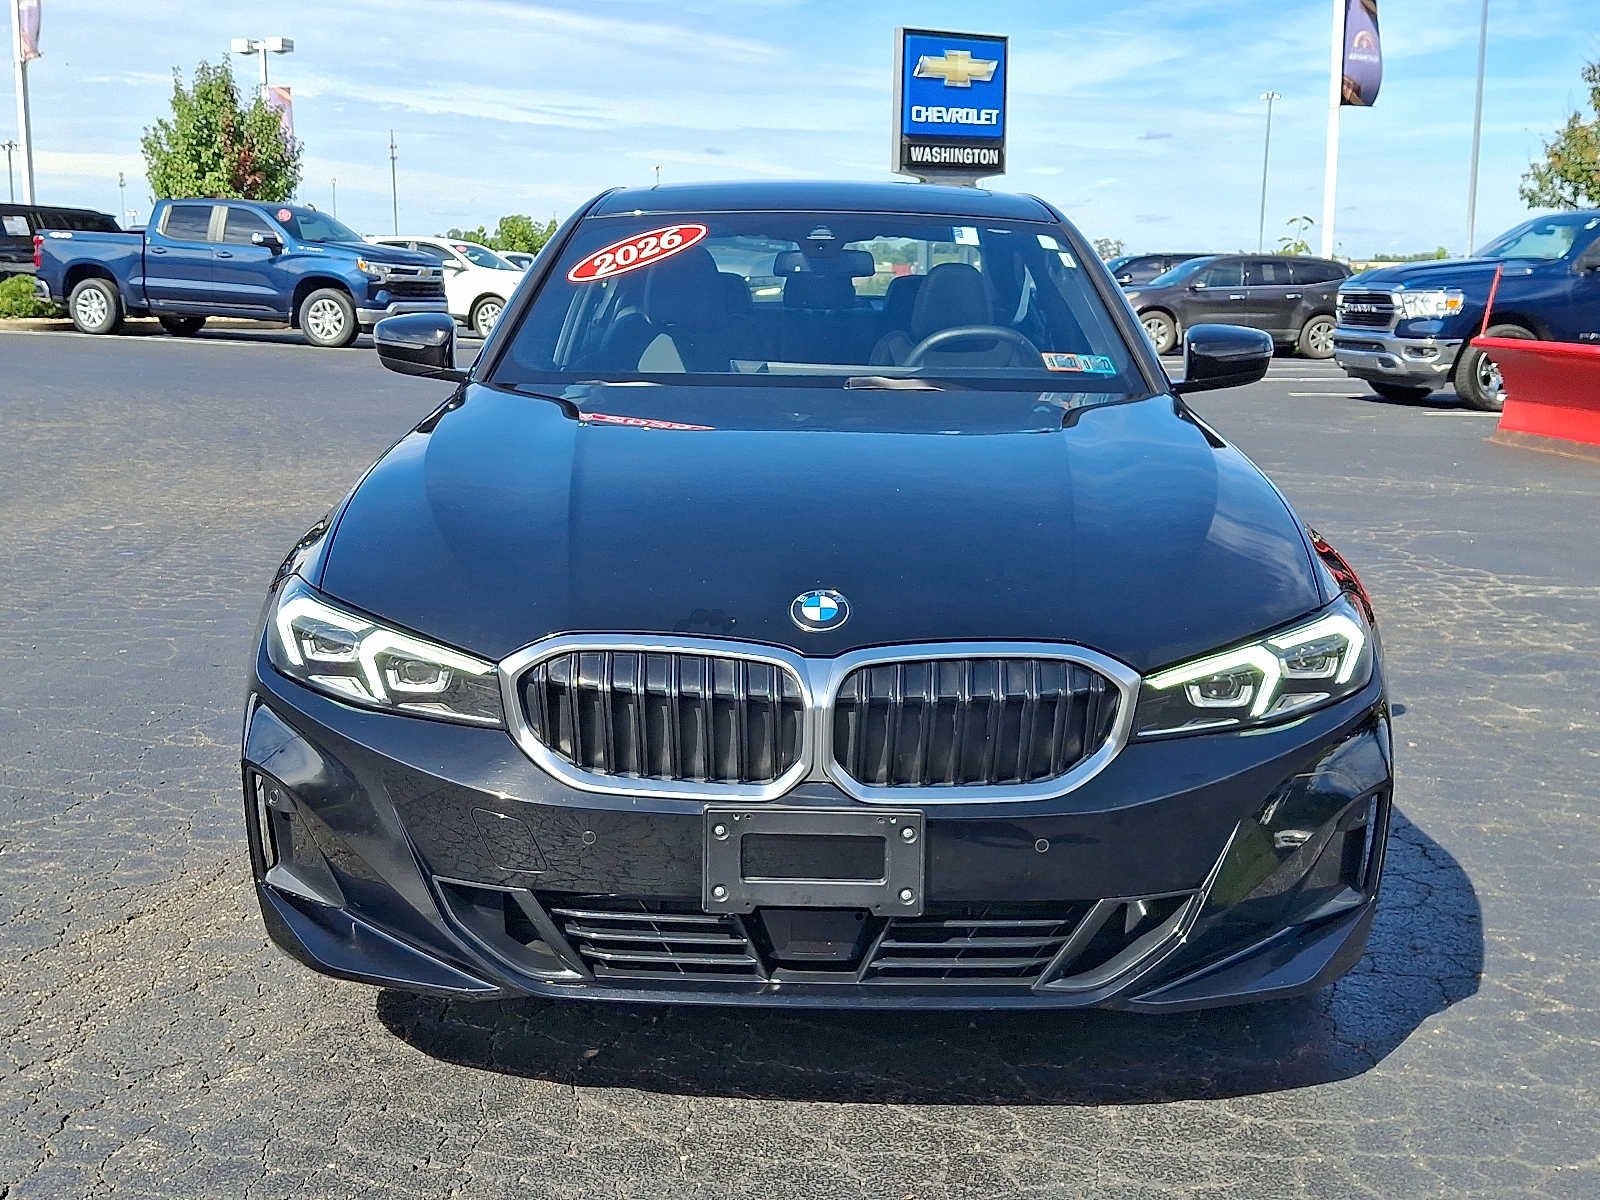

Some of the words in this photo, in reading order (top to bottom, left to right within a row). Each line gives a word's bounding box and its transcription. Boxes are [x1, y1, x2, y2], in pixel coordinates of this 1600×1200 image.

[911, 105, 999, 125] CHEVROLET
[910, 146, 999, 164] WASHINGTON
[592, 228, 683, 276] 2026
